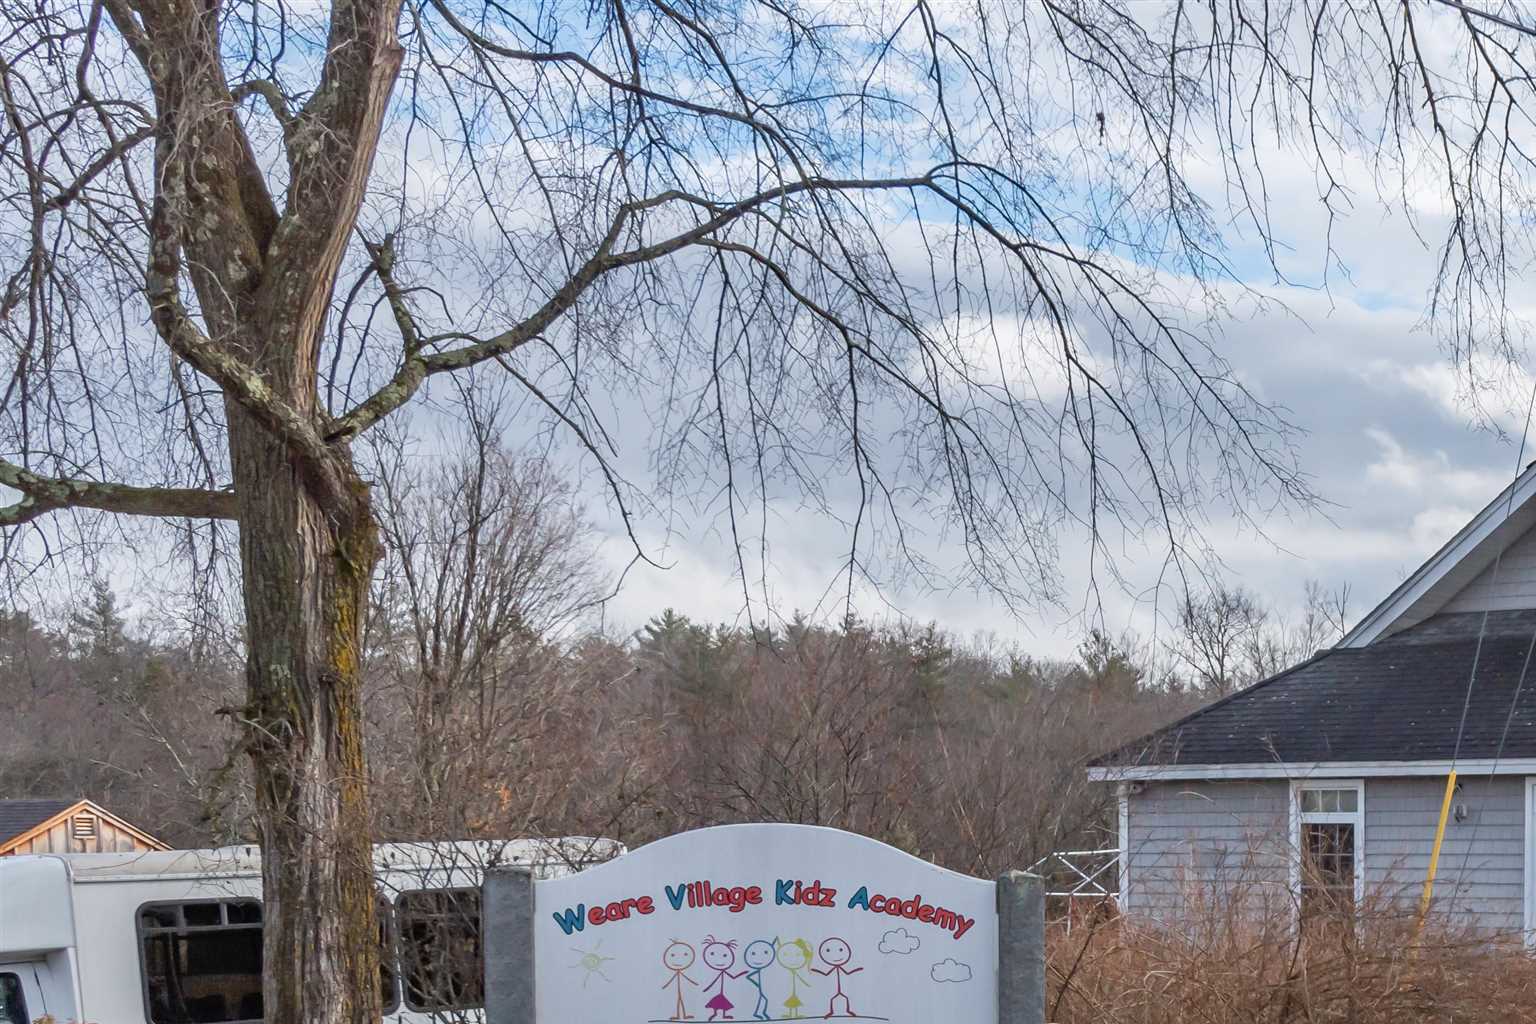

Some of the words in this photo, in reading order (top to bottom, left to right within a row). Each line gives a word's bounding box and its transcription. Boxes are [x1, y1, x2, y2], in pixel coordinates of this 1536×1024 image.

[552, 895, 656, 936] Weare
[664, 880, 763, 913] Village
[774, 878, 837, 908] Kidz
[847, 886, 975, 941] Academy
